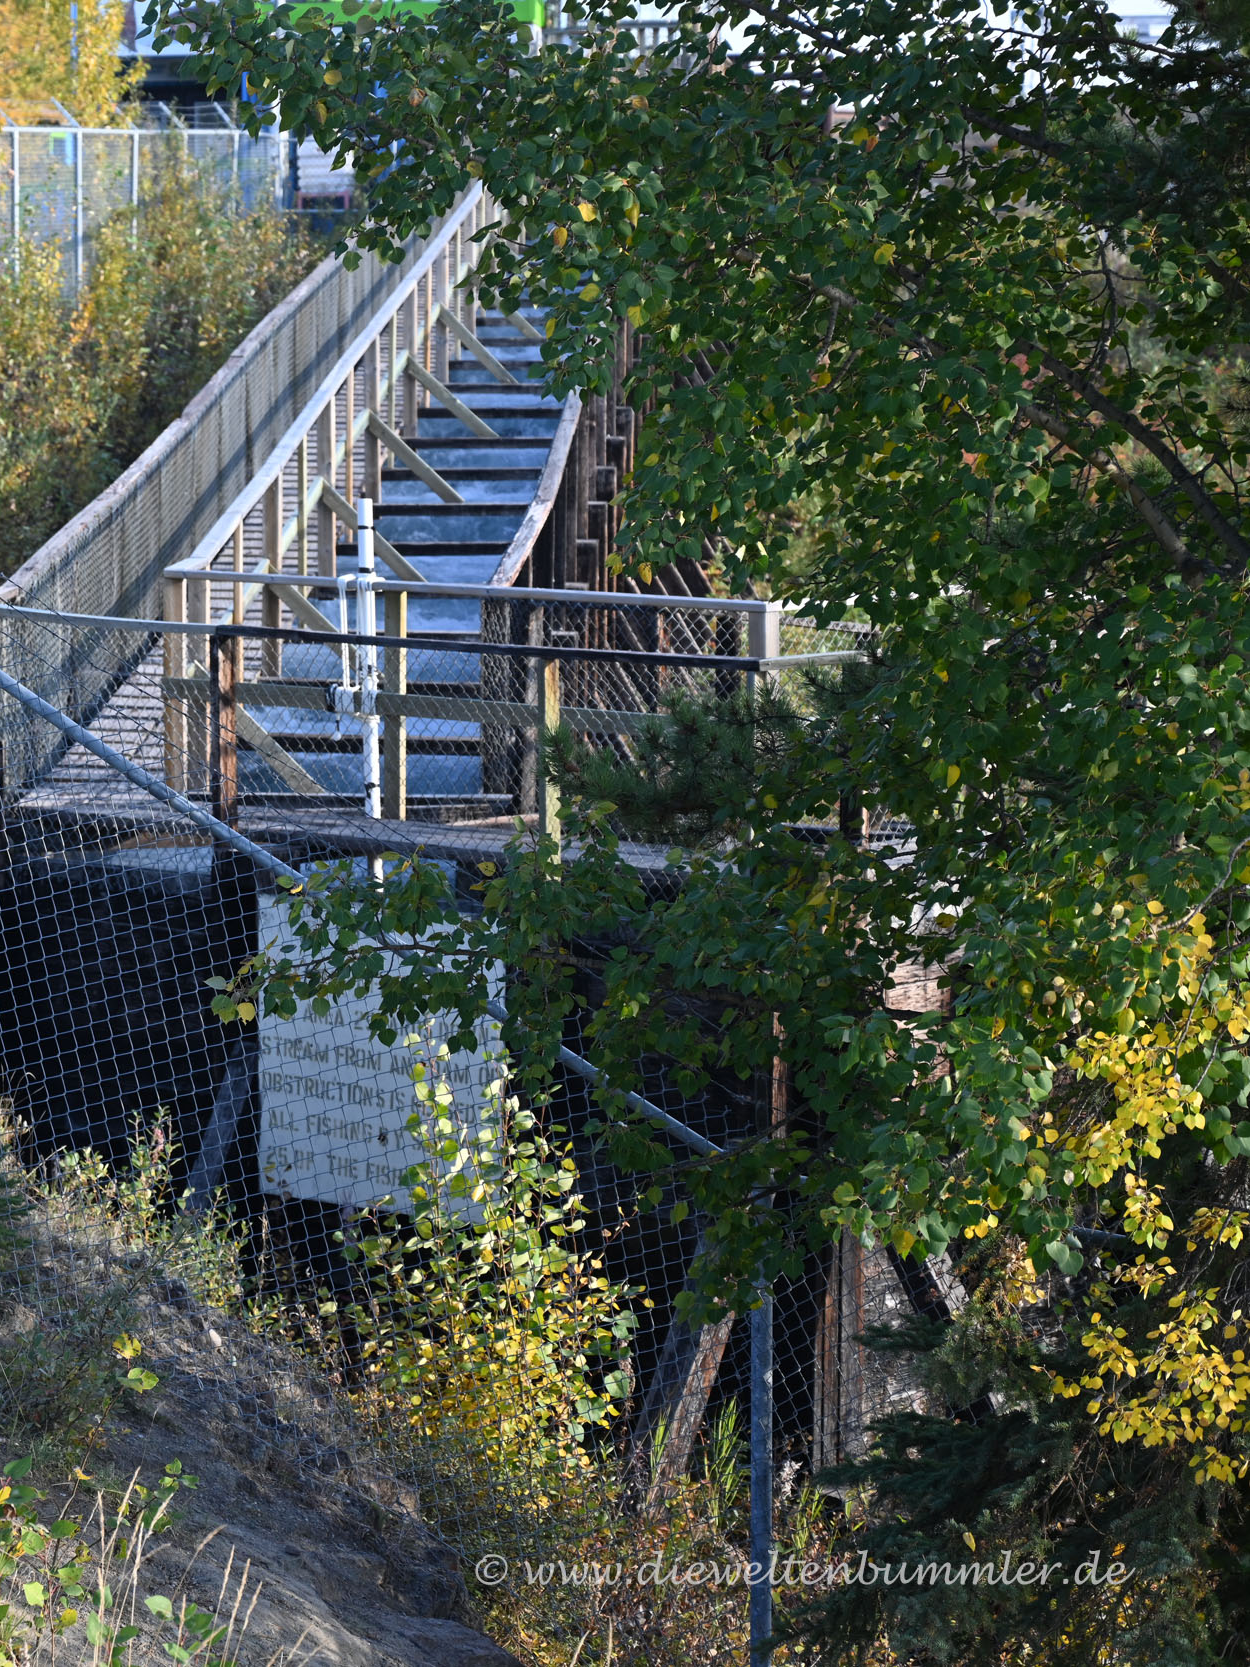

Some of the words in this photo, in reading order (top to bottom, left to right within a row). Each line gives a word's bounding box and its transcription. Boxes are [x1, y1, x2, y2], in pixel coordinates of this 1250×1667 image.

[336, 1046, 382, 1071] FROM
[262, 1071, 384, 1108] OBSTRUCTIONS
[269, 1109, 299, 1131] ALL
[306, 1115, 373, 1143] FISHING
[326, 1153, 358, 1181] THE
